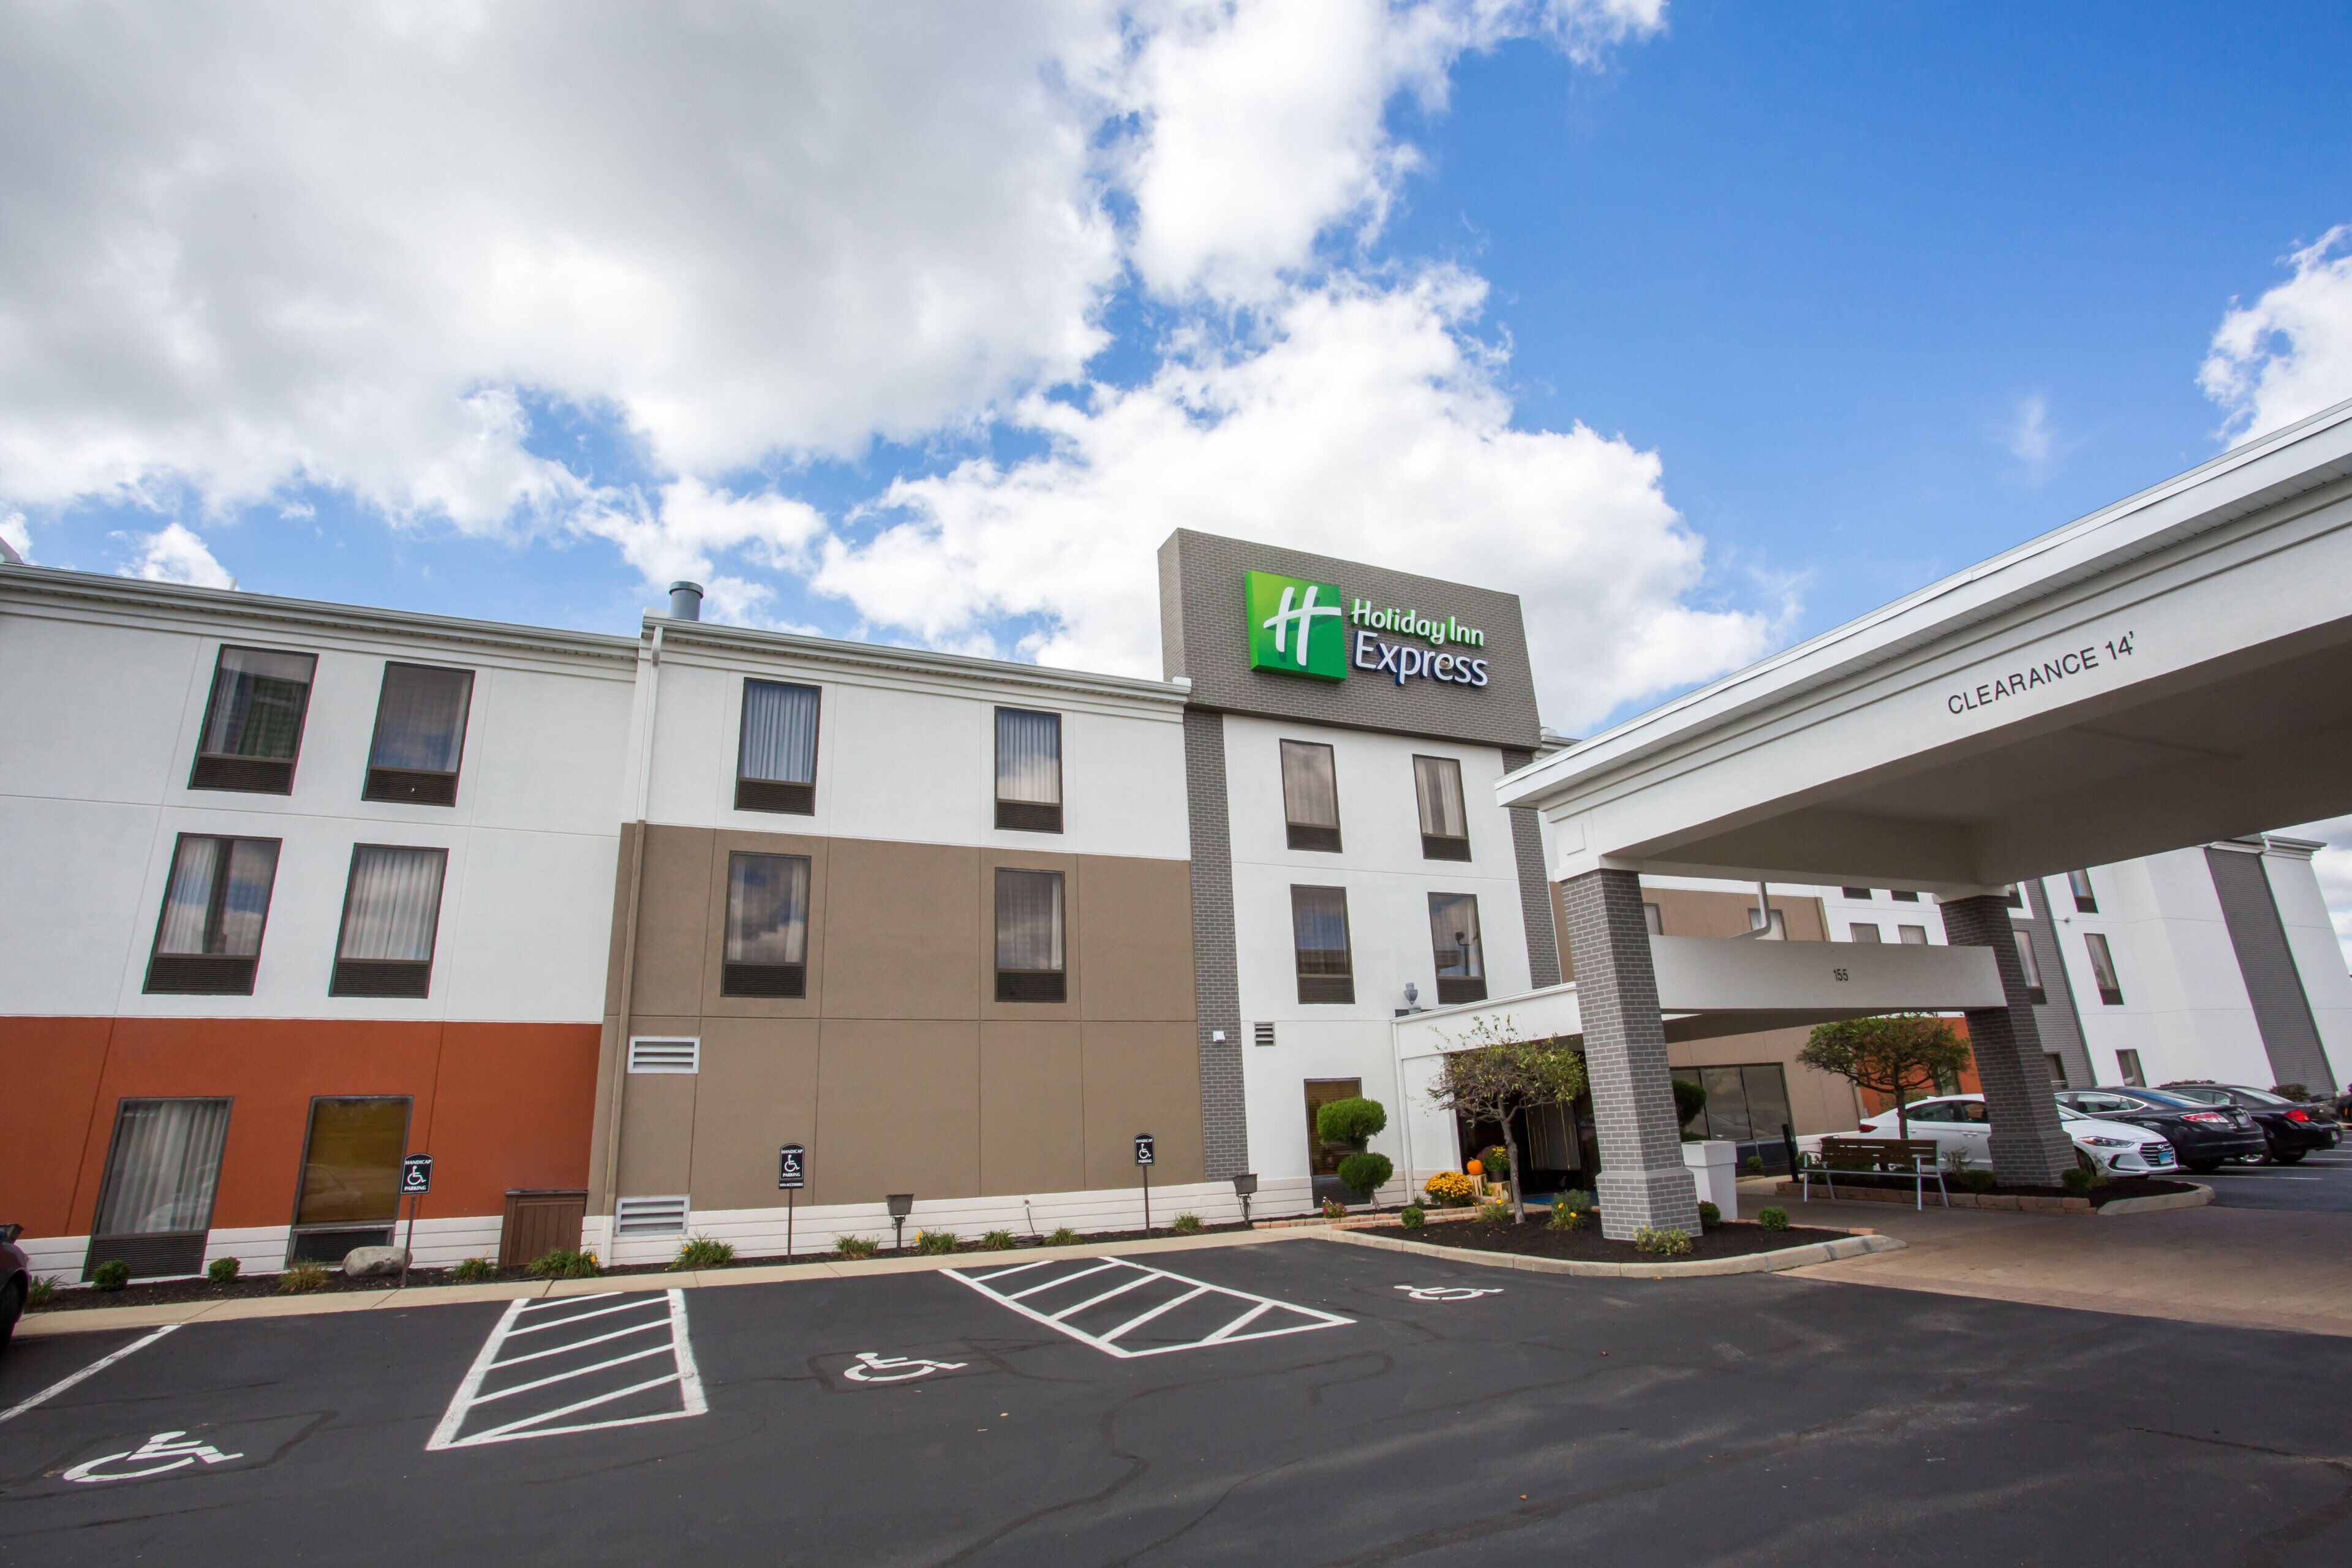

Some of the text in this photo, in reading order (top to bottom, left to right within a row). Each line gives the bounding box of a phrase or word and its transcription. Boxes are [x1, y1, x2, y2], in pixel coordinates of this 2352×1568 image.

[1349, 598, 1484, 647] Holiday Inn
[1353, 630, 1489, 687] Express
[1948, 631, 2134, 715] CLEARANCE 14'
[1833, 968, 1849, 981] 155
